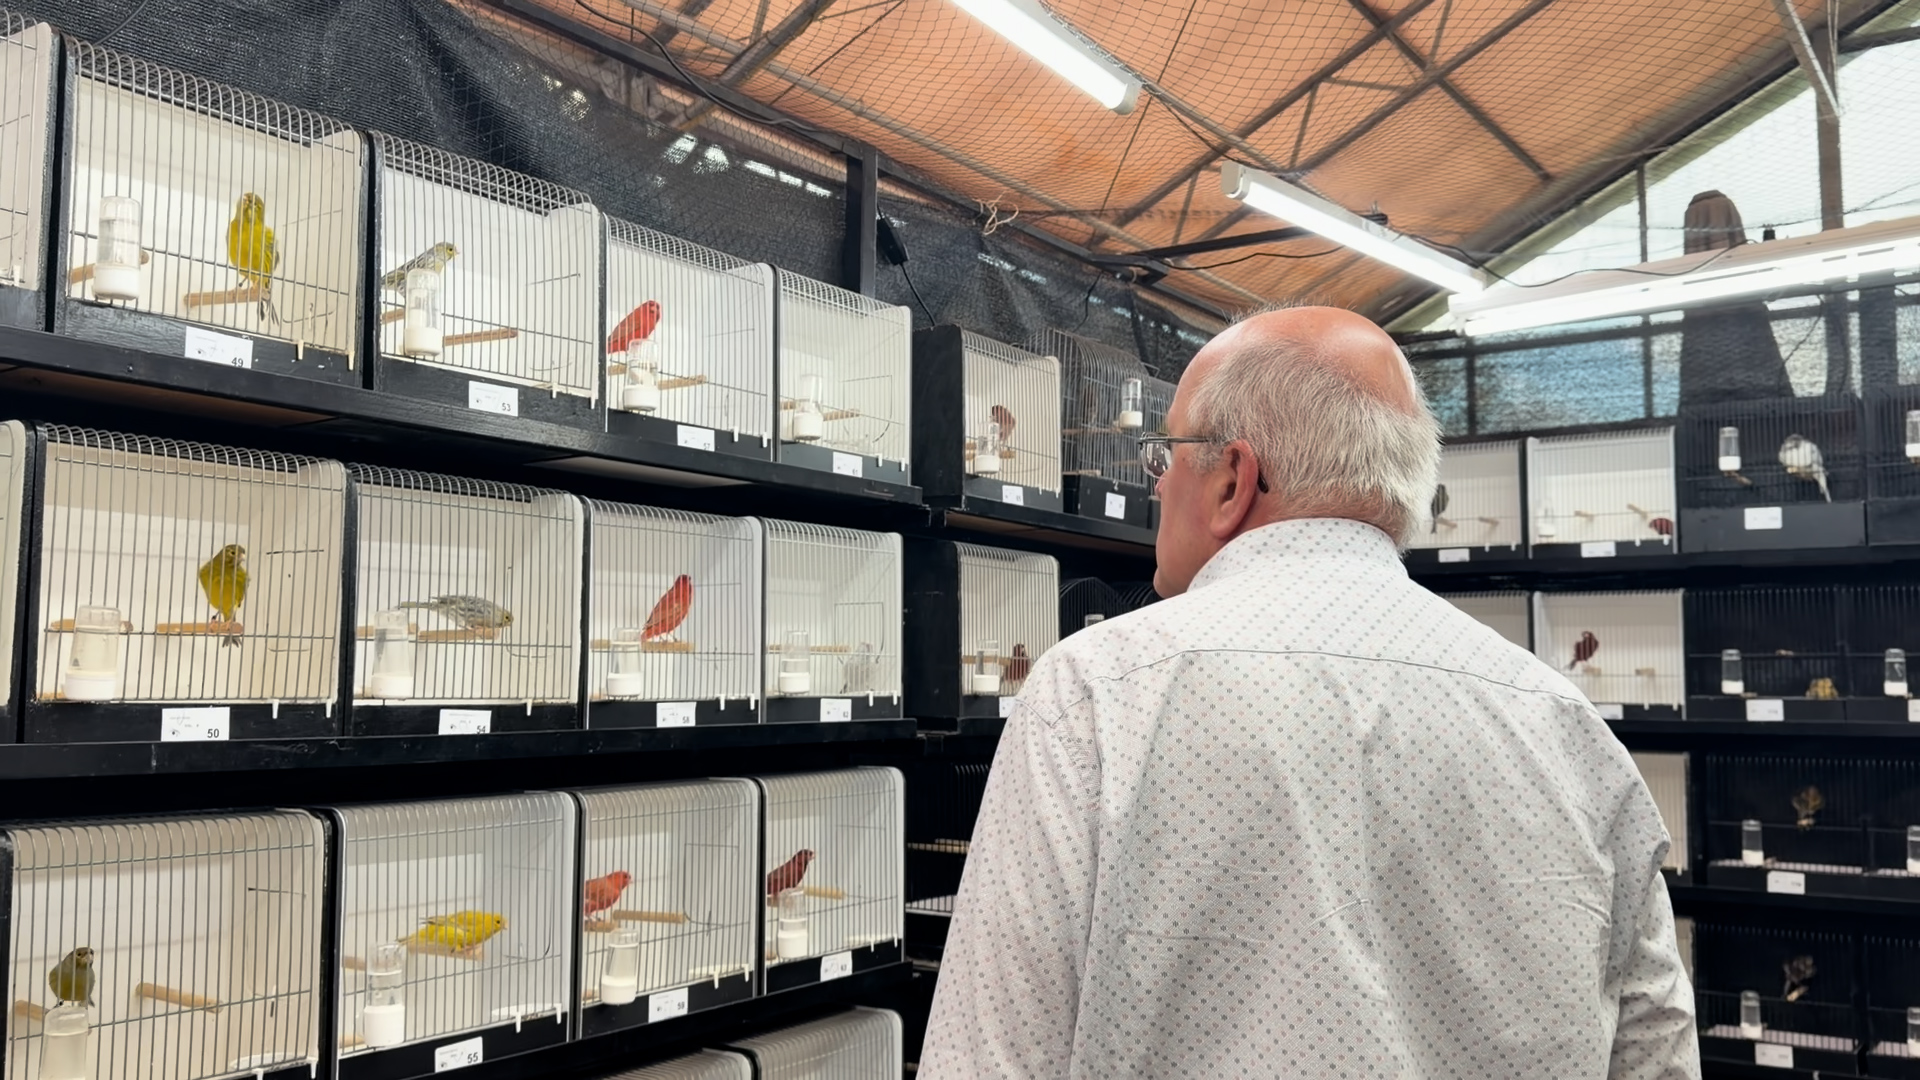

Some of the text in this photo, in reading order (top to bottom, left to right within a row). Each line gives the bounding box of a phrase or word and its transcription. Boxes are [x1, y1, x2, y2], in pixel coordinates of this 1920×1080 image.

[231, 357, 244, 368] 49
[501, 402, 511, 412] 53
[207, 728, 220, 739] 50
[476, 725, 486, 734] 54
[467, 1051, 479, 1064] 55
